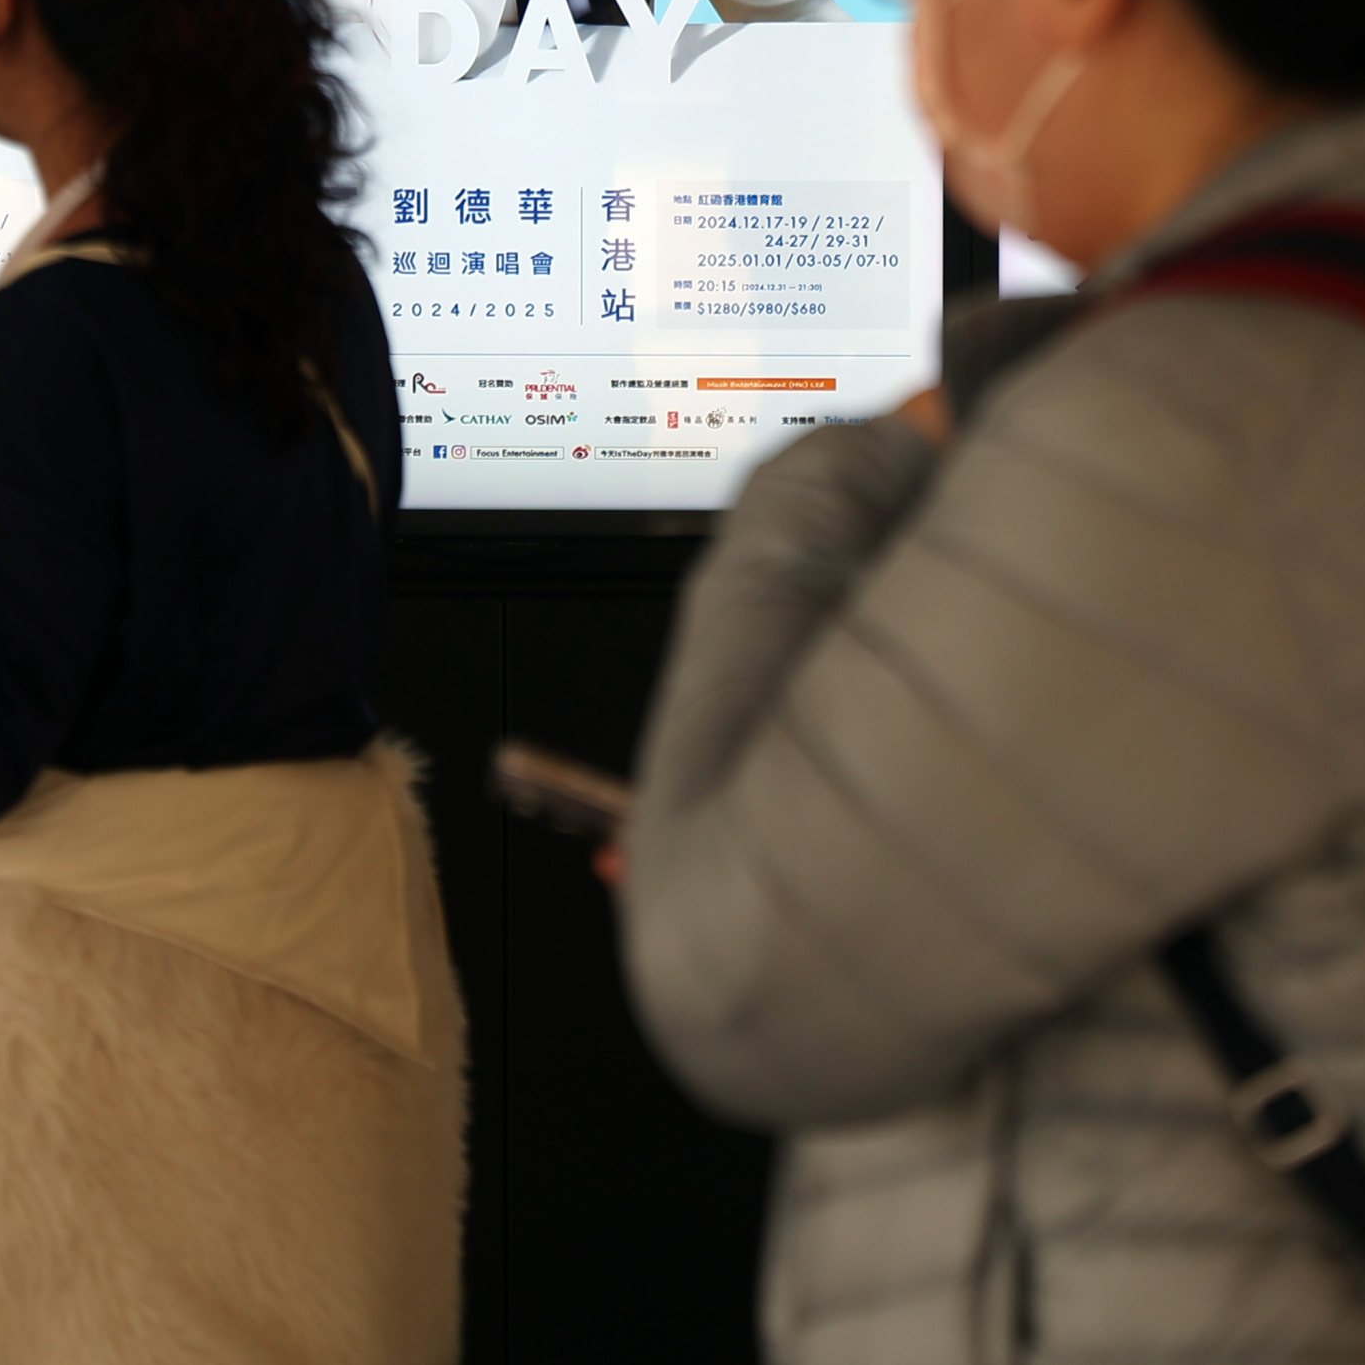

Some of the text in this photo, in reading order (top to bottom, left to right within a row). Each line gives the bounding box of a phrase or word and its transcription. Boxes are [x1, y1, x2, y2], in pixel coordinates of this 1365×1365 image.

[393, 187, 554, 225] 劉德華
[673, 215, 692, 225] 日期
[697, 216, 808, 229] 2024.12.17-19
[825, 216, 870, 229] 21-22
[825, 234, 869, 248] 29-31
[600, 187, 636, 323] 香港站
[392, 251, 554, 275] 巡迴演唱會
[673, 279, 693, 289] 時間
[697, 280, 736, 292] 20:15
[524, 384, 577, 393] PRUDENTIAL
[460, 414, 513, 425] CATHAY
[525, 414, 566, 425] OSIM
[476, 449, 558, 458] Focus Entertainment
